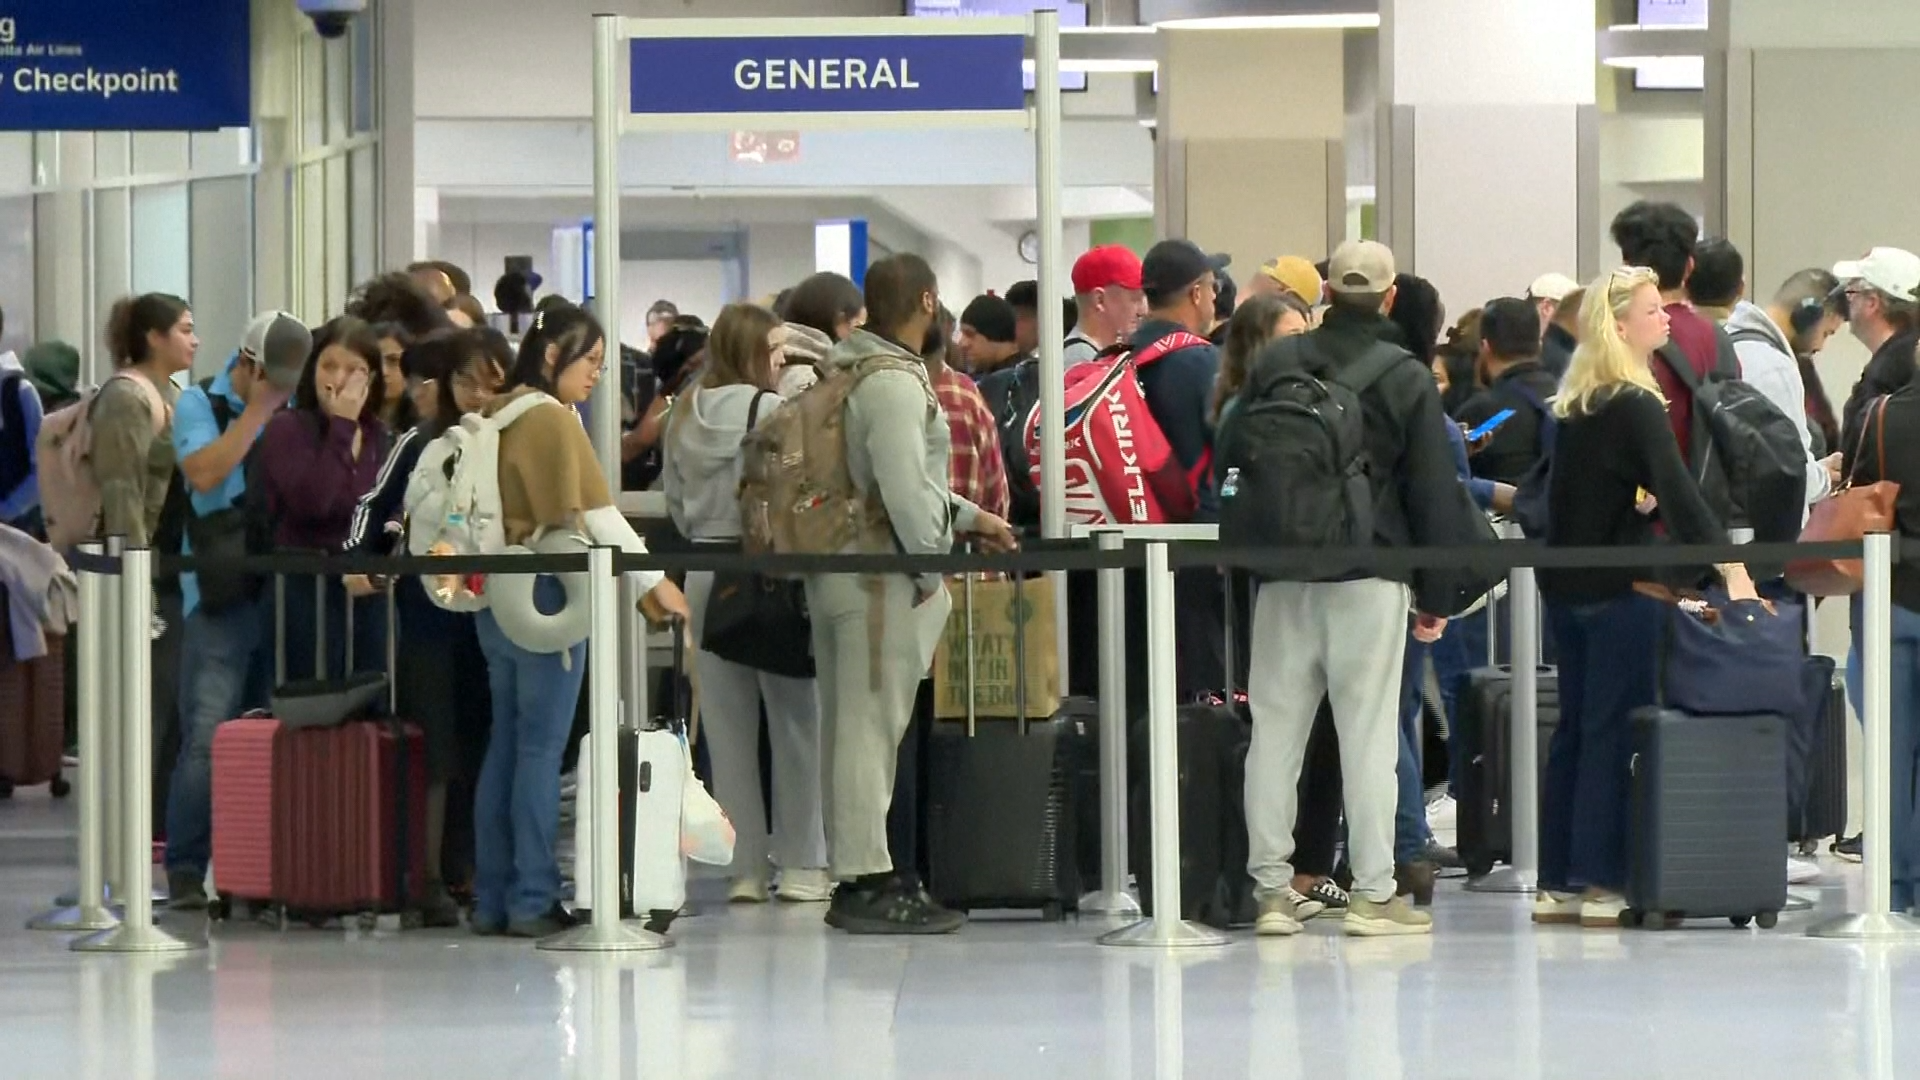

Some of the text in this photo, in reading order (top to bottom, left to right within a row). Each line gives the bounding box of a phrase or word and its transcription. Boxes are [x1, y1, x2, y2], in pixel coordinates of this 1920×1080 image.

[26, 44, 45, 56] Air
[48, 44, 83, 56] Lines
[13, 66, 178, 98] Checkpoint
[734, 58, 919, 90] GENERAL
[1104, 390, 1148, 523] ELKIRK
